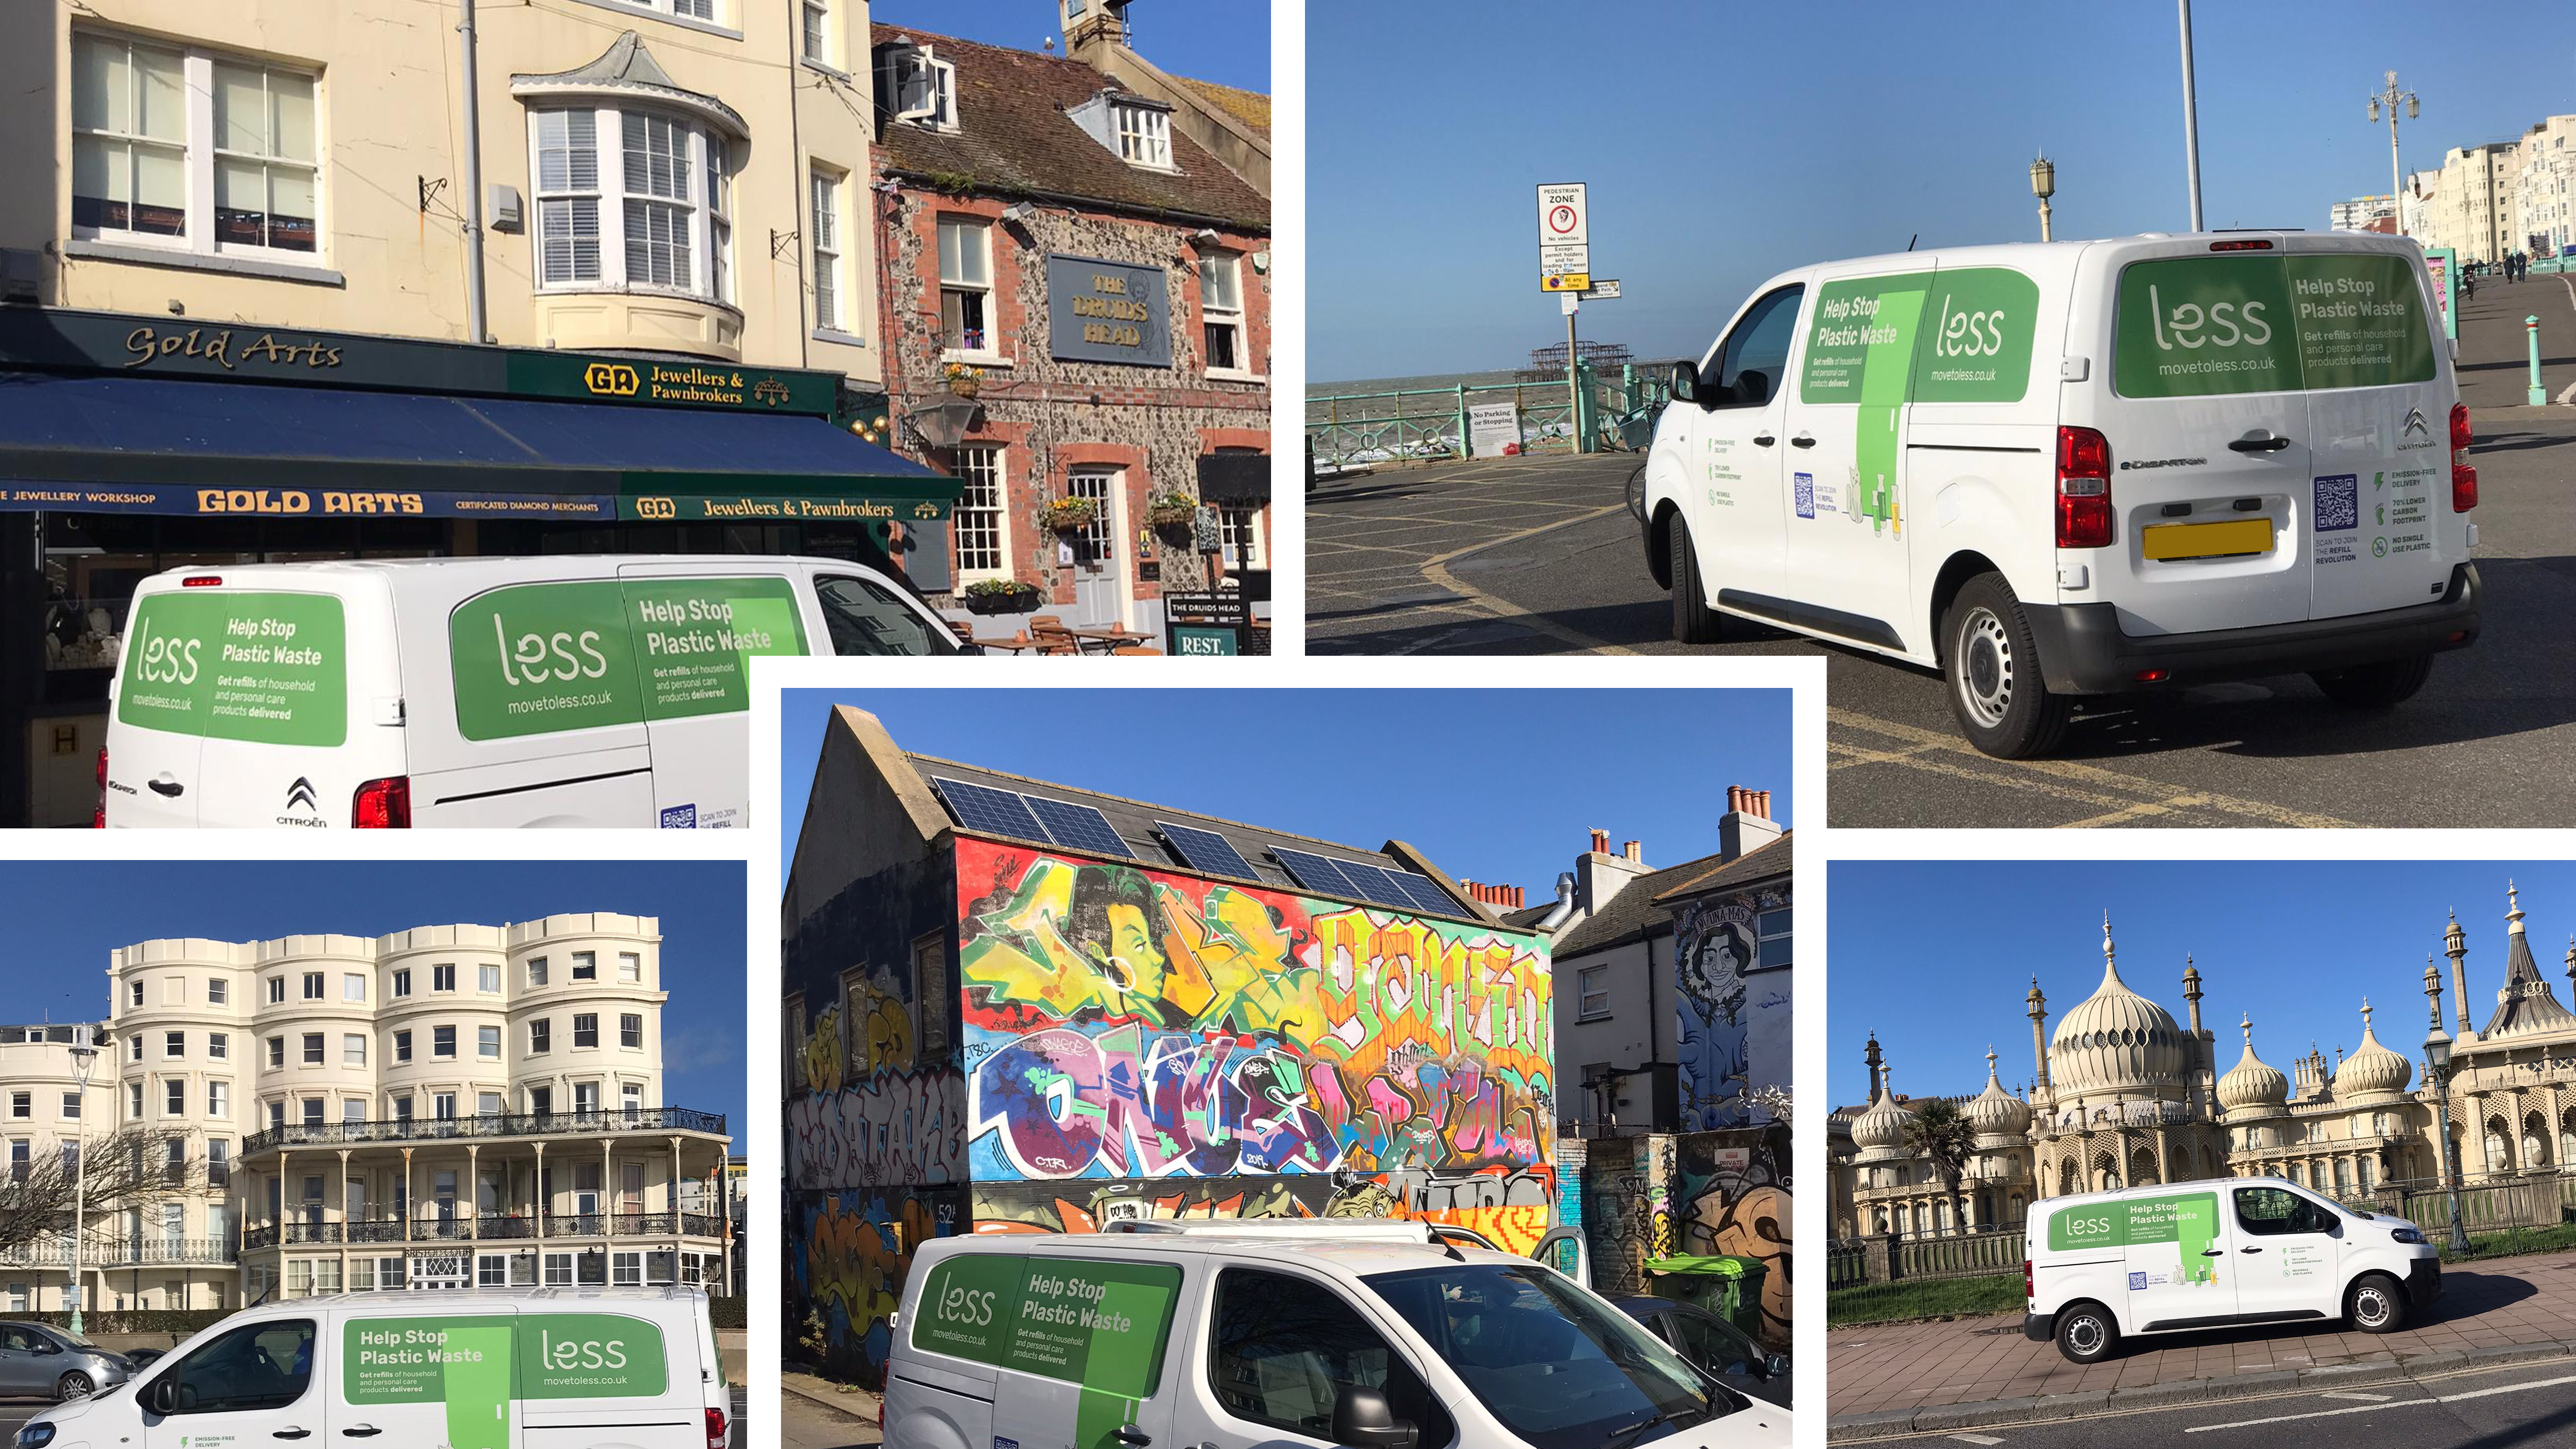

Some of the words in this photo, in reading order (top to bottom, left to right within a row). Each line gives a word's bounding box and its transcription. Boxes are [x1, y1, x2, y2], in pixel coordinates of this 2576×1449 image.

[1549, 195, 1574, 203] ZONE
[1092, 274, 1126, 296] THE
[2296, 278, 2334, 297] Help
[2337, 278, 2375, 297] Stop
[1072, 296, 1148, 322] DRUIDS
[1823, 297, 1849, 321] Help
[1851, 296, 1880, 320] Stop
[2150, 285, 2272, 350] less
[2300, 302, 2357, 318] Plastic
[2360, 300, 2404, 316] Waste
[1937, 294, 2005, 357] less
[2304, 331, 2322, 341] Get
[2324, 330, 2351, 341] refills
[2353, 329, 2362, 339] of
[2363, 327, 2406, 340] household
[1084, 323, 1140, 347] HEAD
[1817, 326, 1858, 347] Plastic
[1860, 324, 1897, 345] Waste
[124, 327, 235, 368] Gold
[241, 334, 342, 367] Arts
[2306, 344, 2324, 354] and
[2326, 341, 2363, 355] personal
[2365, 343, 2383, 351] care
[2159, 357, 2276, 376] movetoless.co.uk
[2308, 356, 2349, 369] products
[2351, 354, 2391, 365] delivered
[650, 365, 726, 386] Jewellers
[729, 372, 744, 388] &
[1932, 368, 1996, 382] movetoless.co.uk
[652, 385, 743, 405] Pawnbrokers
[2392, 468, 2436, 478] EMISSION-FREE
[2392, 479, 2420, 488] DELIVERY
[13, 491, 81, 501] JEWELLERY
[86, 492, 156, 503] WORKSHOP
[197, 489, 310, 513] GOLD
[323, 492, 423, 514] ARTS
[456, 501, 508, 510] CERTIFICATED
[510, 502, 549, 511] DIAMOND
[552, 503, 598, 512] MERCHANTS
[704, 499, 779, 518] Jewellers
[783, 502, 796, 516] &
[800, 500, 893, 518] Pawnbrokers
[2393, 507, 2417, 515] CARBON
[2393, 516, 2426, 525] FOOTPRINT
[2315, 538, 2334, 547] SCAN
[2330, 546, 2351, 554] REFILL
[2406, 543, 2430, 551] PLASTIC
[2316, 554, 2356, 564] REVOLUTION
[639, 600, 686, 625] Help
[689, 598, 733, 624] Stop
[228, 618, 258, 638] Help
[261, 619, 296, 640] Stop
[138, 616, 201, 685] less
[494, 613, 607, 686] less
[647, 629, 715, 655] Plastic
[718, 628, 771, 651] Waste
[1182, 636, 1225, 655] REST,
[222, 644, 270, 664] Plastic
[273, 646, 321, 666] Waste
[653, 668, 667, 677] Get
[669, 666, 690, 677] refills
[700, 662, 734, 673] household
[218, 676, 232, 686] Get
[233, 676, 256, 688] refills
[258, 677, 267, 688] of
[269, 678, 315, 691] household
[656, 679, 670, 690] and
[672, 678, 700, 690] personal
[702, 677, 717, 686] care
[132, 693, 192, 711] movetoless.co.uk
[215, 690, 229, 700] and
[231, 691, 265, 704] personal
[266, 695, 285, 704] care
[508, 690, 612, 714] movetoless.co.uk
[658, 691, 690, 704] products
[691, 688, 724, 701] delivered
[213, 704, 246, 717] products
[248, 706, 291, 720] delivered
[2130, 1205, 2152, 1214] Help
[2154, 1203, 2178, 1212] Stop
[2066, 1214, 2110, 1236] less
[2130, 1214, 2165, 1224] Plastic
[2167, 1212, 2197, 1221] Waste
[2067, 1236, 2110, 1244] movetoless.co.uk
[1029, 1274, 1064, 1298] Help
[1066, 1279, 1106, 1303] Stop
[937, 1272, 995, 1327] less
[1022, 1300, 1075, 1325] Plastic
[1080, 1308, 1131, 1332] Waste
[360, 1331, 401, 1349] Help
[405, 1330, 448, 1347] Stop
[933, 1328, 986, 1346] movetoless.co.uk
[1018, 1328, 1028, 1337] Get
[1029, 1330, 1046, 1340] refills
[1054, 1333, 1084, 1347] household
[543, 1330, 626, 1370] less
[1026, 1341, 1050, 1352] personal
[360, 1349, 423, 1365] Plastic
[427, 1348, 482, 1364] Waste
[1013, 1349, 1037, 1361] products
[1038, 1352, 1067, 1365] delivered
[374, 1379, 400, 1387] personal
[544, 1376, 628, 1385] movetoless.co.uk
